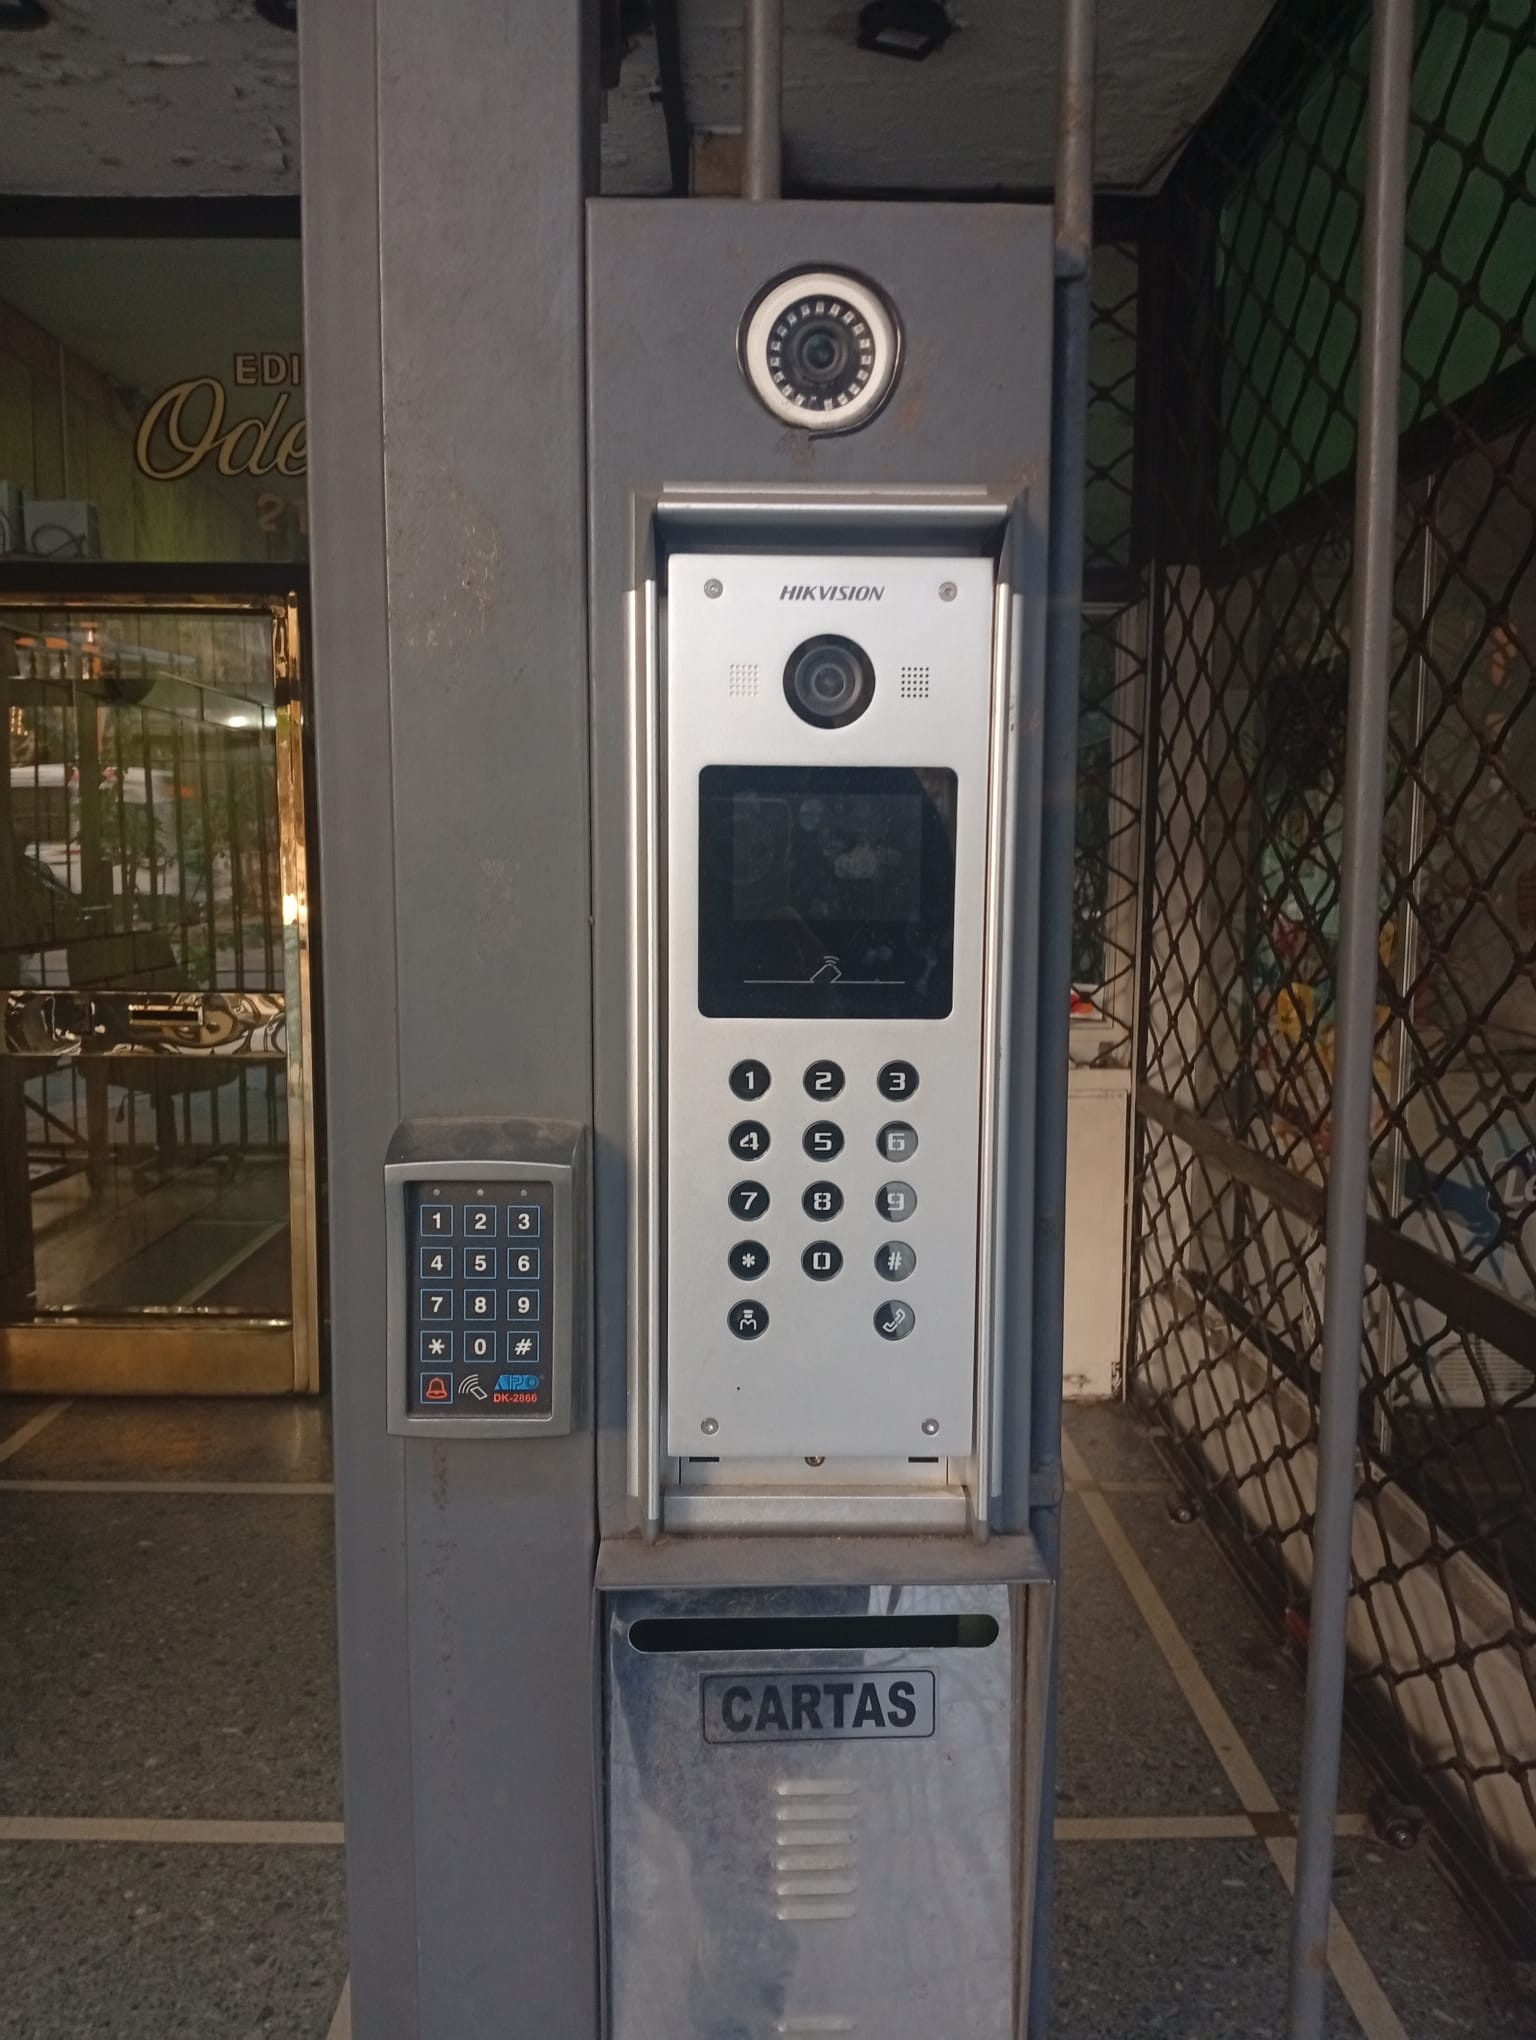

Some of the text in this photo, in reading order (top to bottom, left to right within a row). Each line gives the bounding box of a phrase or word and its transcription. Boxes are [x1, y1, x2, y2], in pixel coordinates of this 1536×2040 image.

[779, 585, 885, 601] HIKVISION
[745, 1071, 906, 1091] 1 2 3
[739, 1131, 905, 1151] 4 5 6
[740, 1191, 905, 1211] 7 8 9
[432, 1212, 530, 1230] 1 2 3
[430, 1254, 530, 1272] 4 5 6
[812, 1252, 831, 1270] 0
[431, 1296, 530, 1314] 7 8 9
[473, 1338, 487, 1355] 0
[494, 1393, 537, 1403] DK-2866
[721, 1681, 916, 1732] CARTAS
